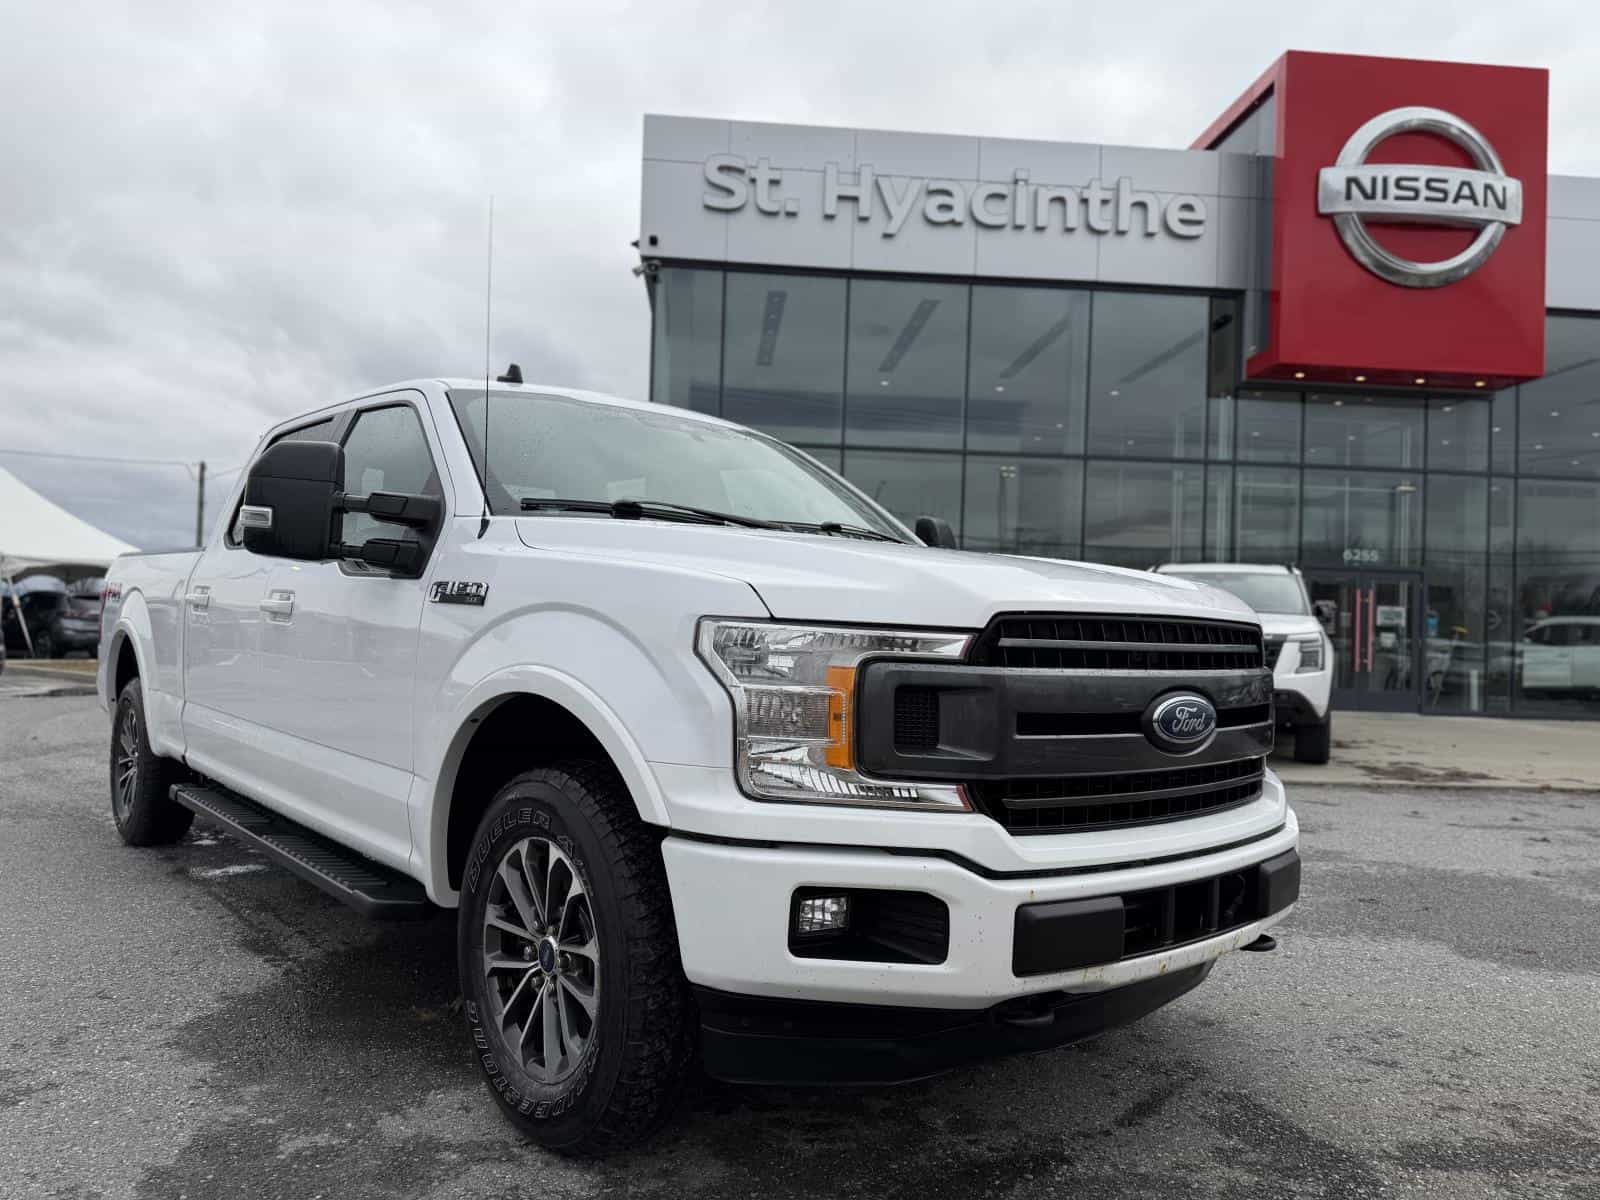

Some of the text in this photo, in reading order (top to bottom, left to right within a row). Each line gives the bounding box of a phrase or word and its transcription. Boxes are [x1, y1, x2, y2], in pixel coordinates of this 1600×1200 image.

[702, 153, 1208, 238] St. Hyacinthe
[1344, 176, 1507, 210] NISSAN
[1171, 705, 1206, 732] Ford
[467, 806, 552, 894] DUELER
